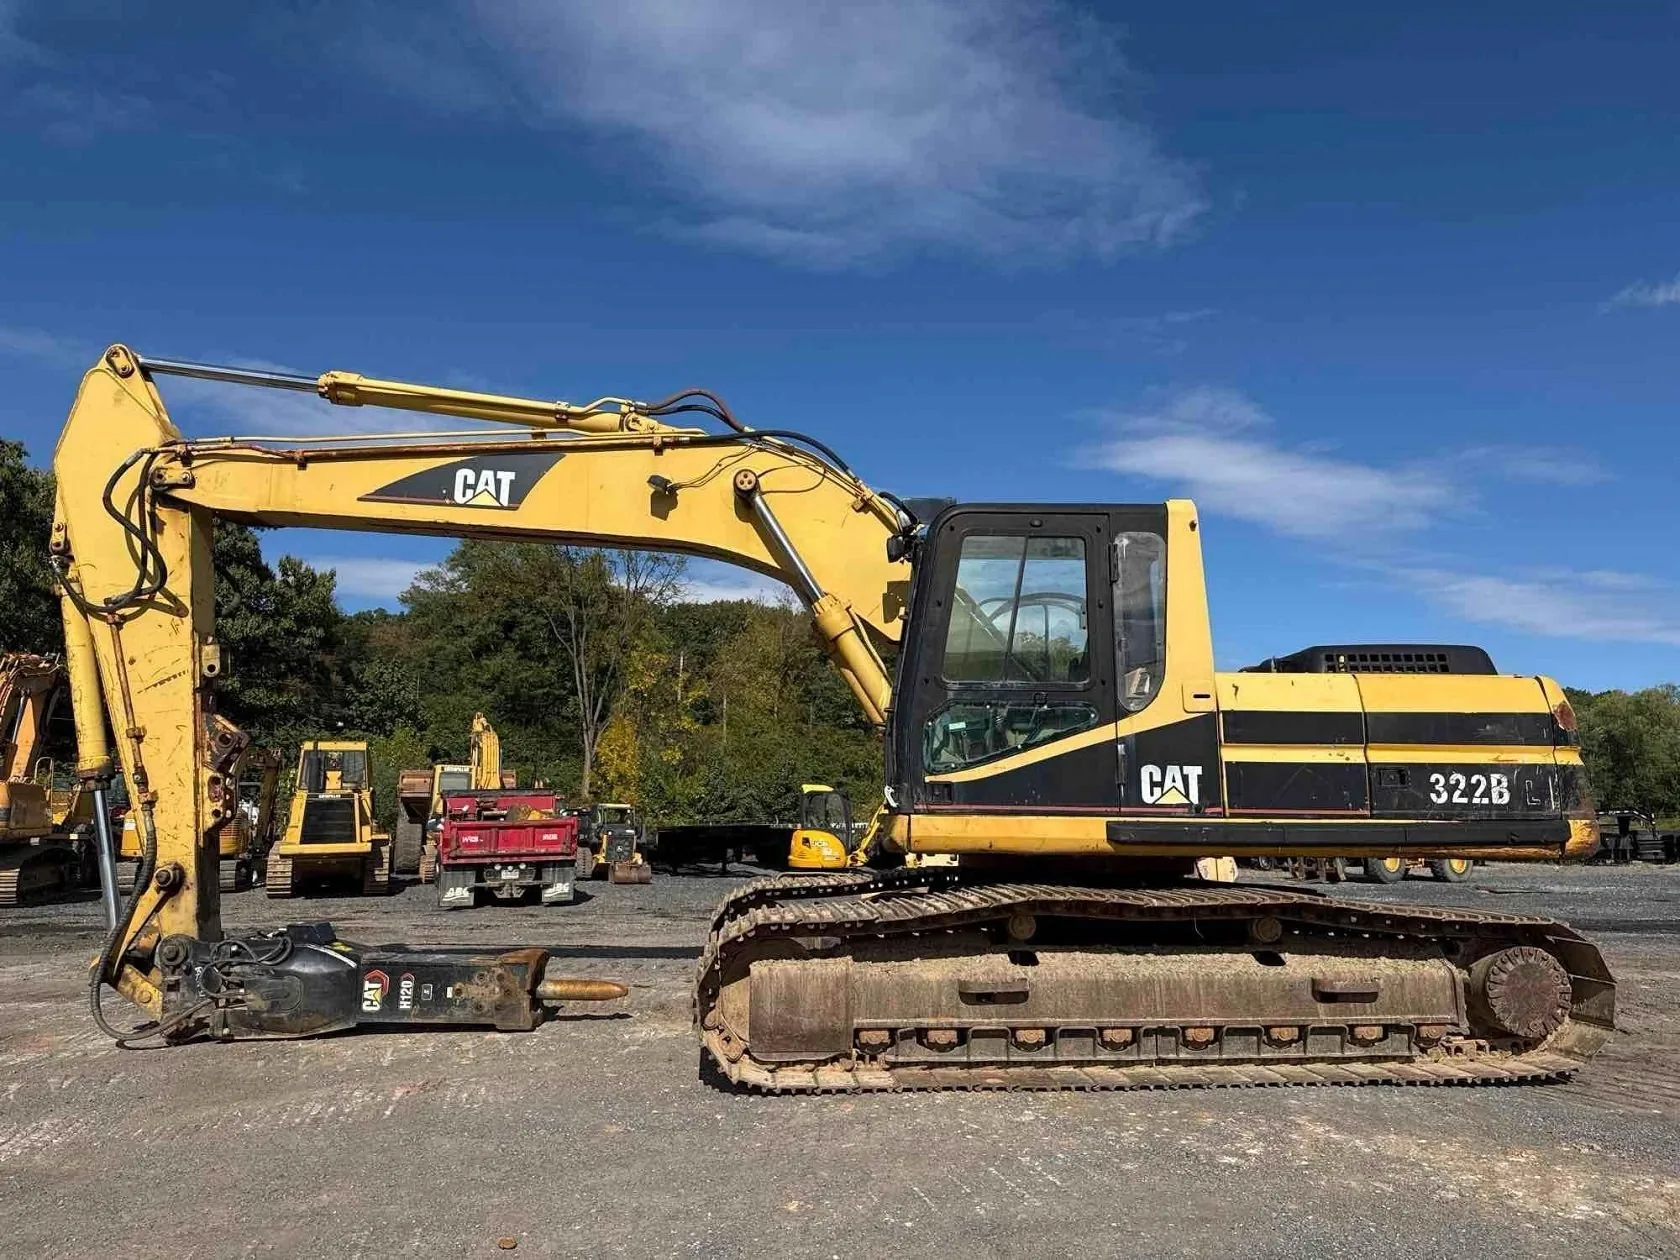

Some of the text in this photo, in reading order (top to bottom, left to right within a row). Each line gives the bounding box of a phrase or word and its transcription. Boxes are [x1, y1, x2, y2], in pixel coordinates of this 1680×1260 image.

[454, 468, 515, 506] CAT
[1141, 764, 1202, 804] CAT
[1430, 773, 1511, 804] 322B
[362, 980, 383, 1011] CAT
[400, 980, 413, 1009] H120
